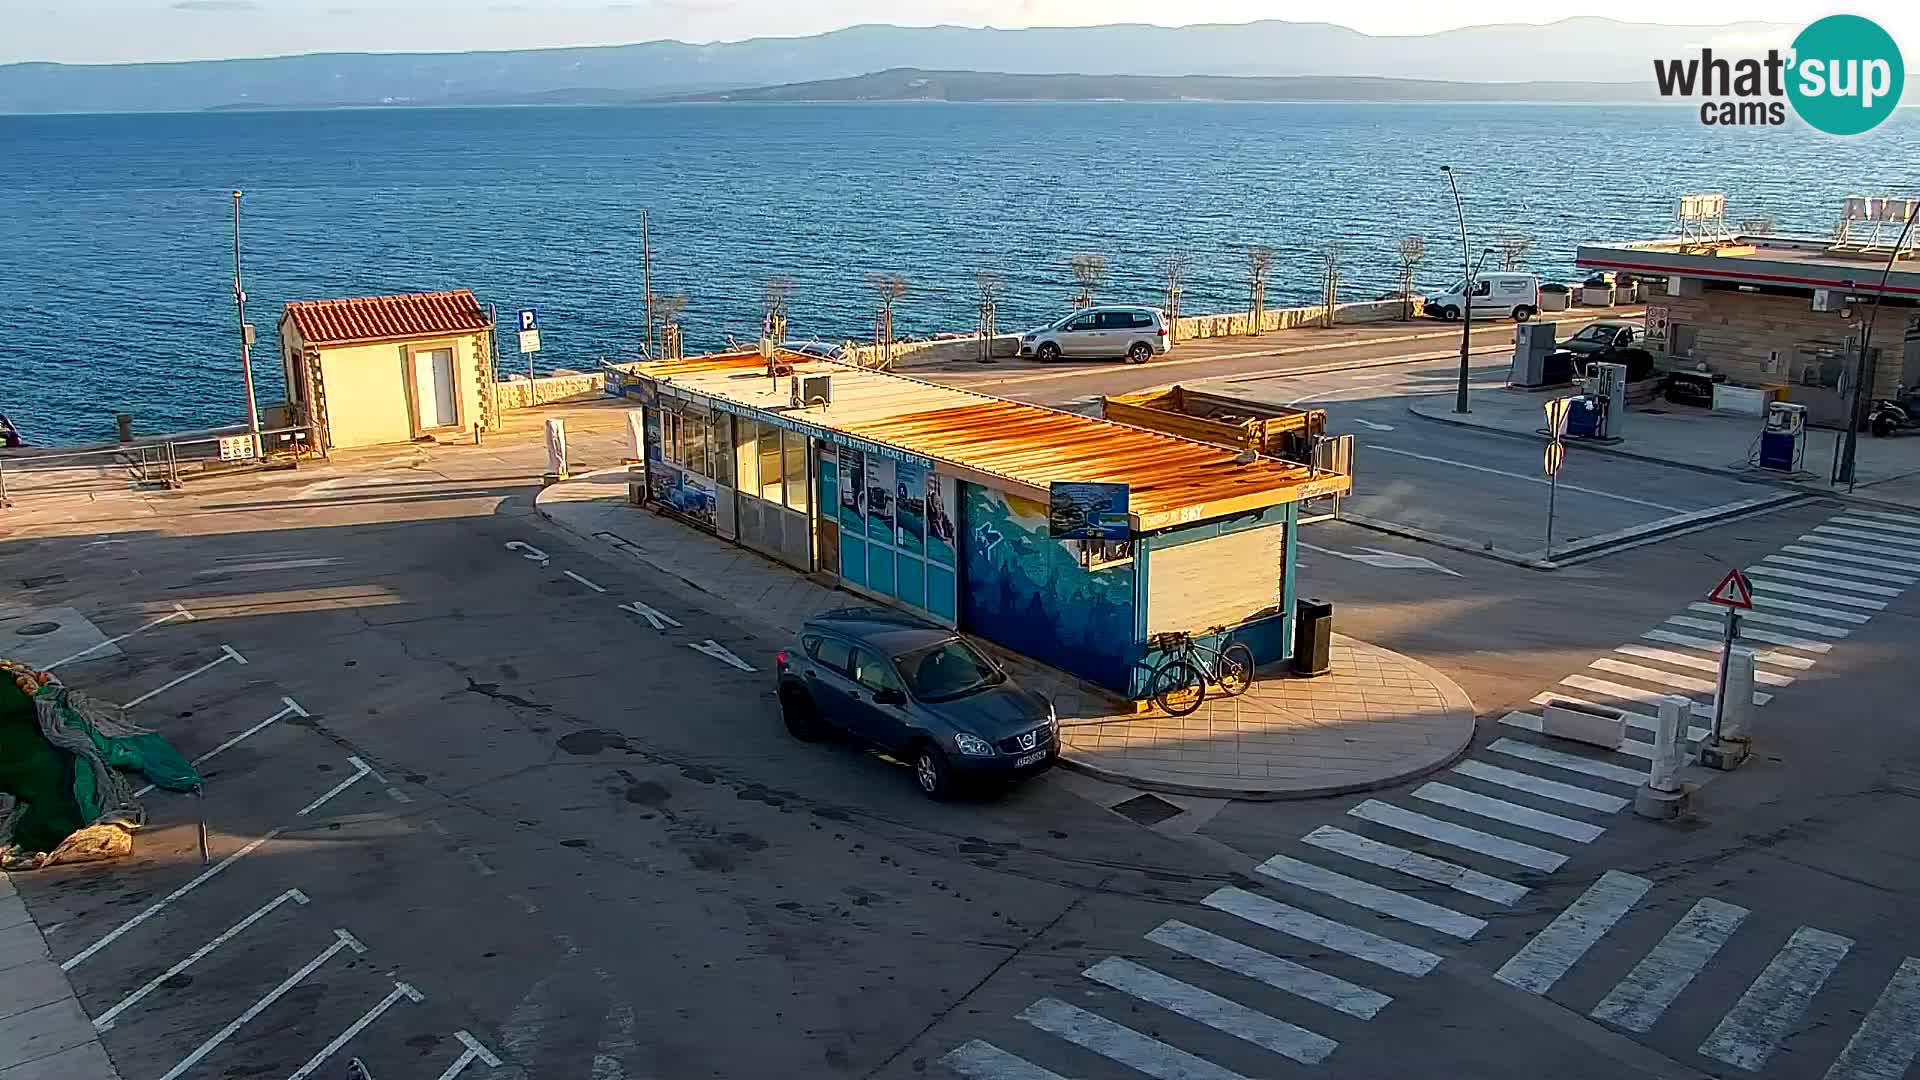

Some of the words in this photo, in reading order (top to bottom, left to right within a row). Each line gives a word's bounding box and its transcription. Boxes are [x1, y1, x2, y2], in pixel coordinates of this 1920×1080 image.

[522, 311, 534, 329] P
[847, 438, 879, 455] STATION
[880, 446, 904, 461] TICKET
[905, 453, 931, 469] OFFICE
